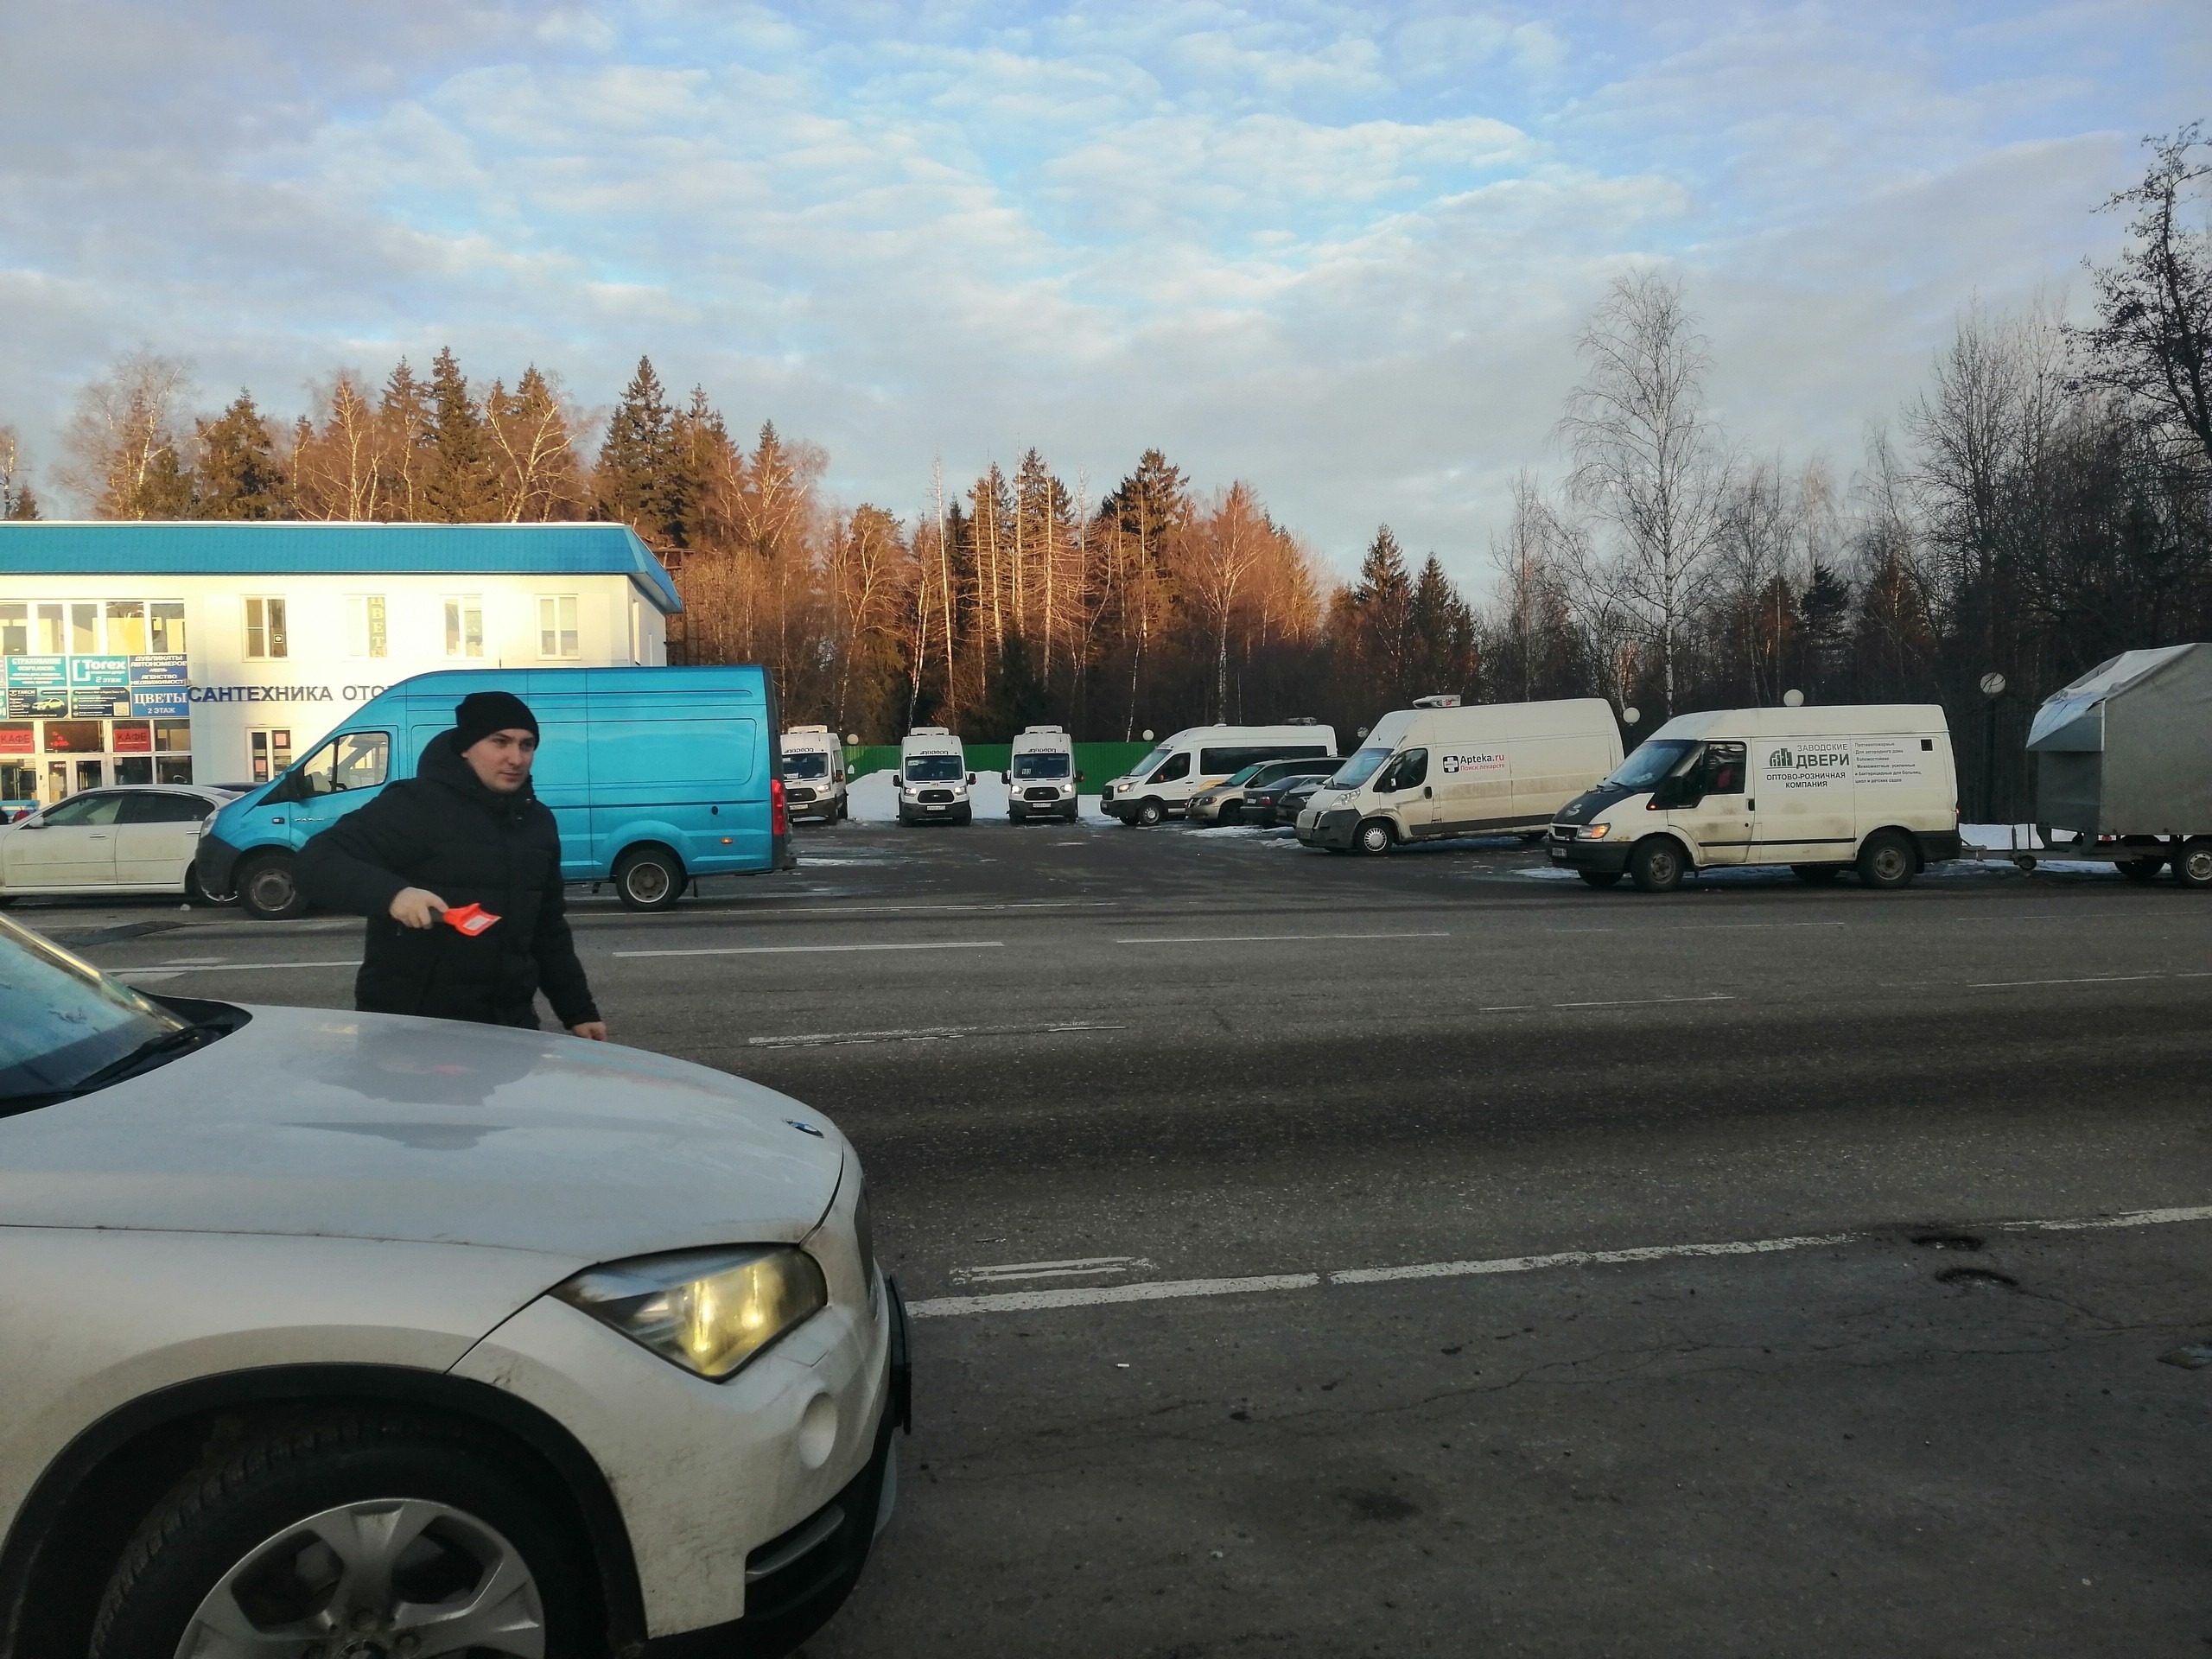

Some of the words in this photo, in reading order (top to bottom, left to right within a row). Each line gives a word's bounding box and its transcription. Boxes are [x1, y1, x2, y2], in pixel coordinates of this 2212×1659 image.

[81, 659, 126, 670] Torex
[134, 692, 188, 706] ЦВЕТЫ
[188, 686, 334, 702] САНТЕХНИКА
[342, 685, 393, 701] ОТО
[0, 734, 30, 743] КАФЕ
[117, 732, 147, 741] КАФЕ
[1797, 743, 1848, 752] ЗАВОДСКИЕ
[1460, 753, 1504, 765] Apteka.ru
[1796, 753, 1850, 769] ДВЕРИ
[1766, 772, 1846, 781] ОПТОВО-РОЗНИЧНАЯ
